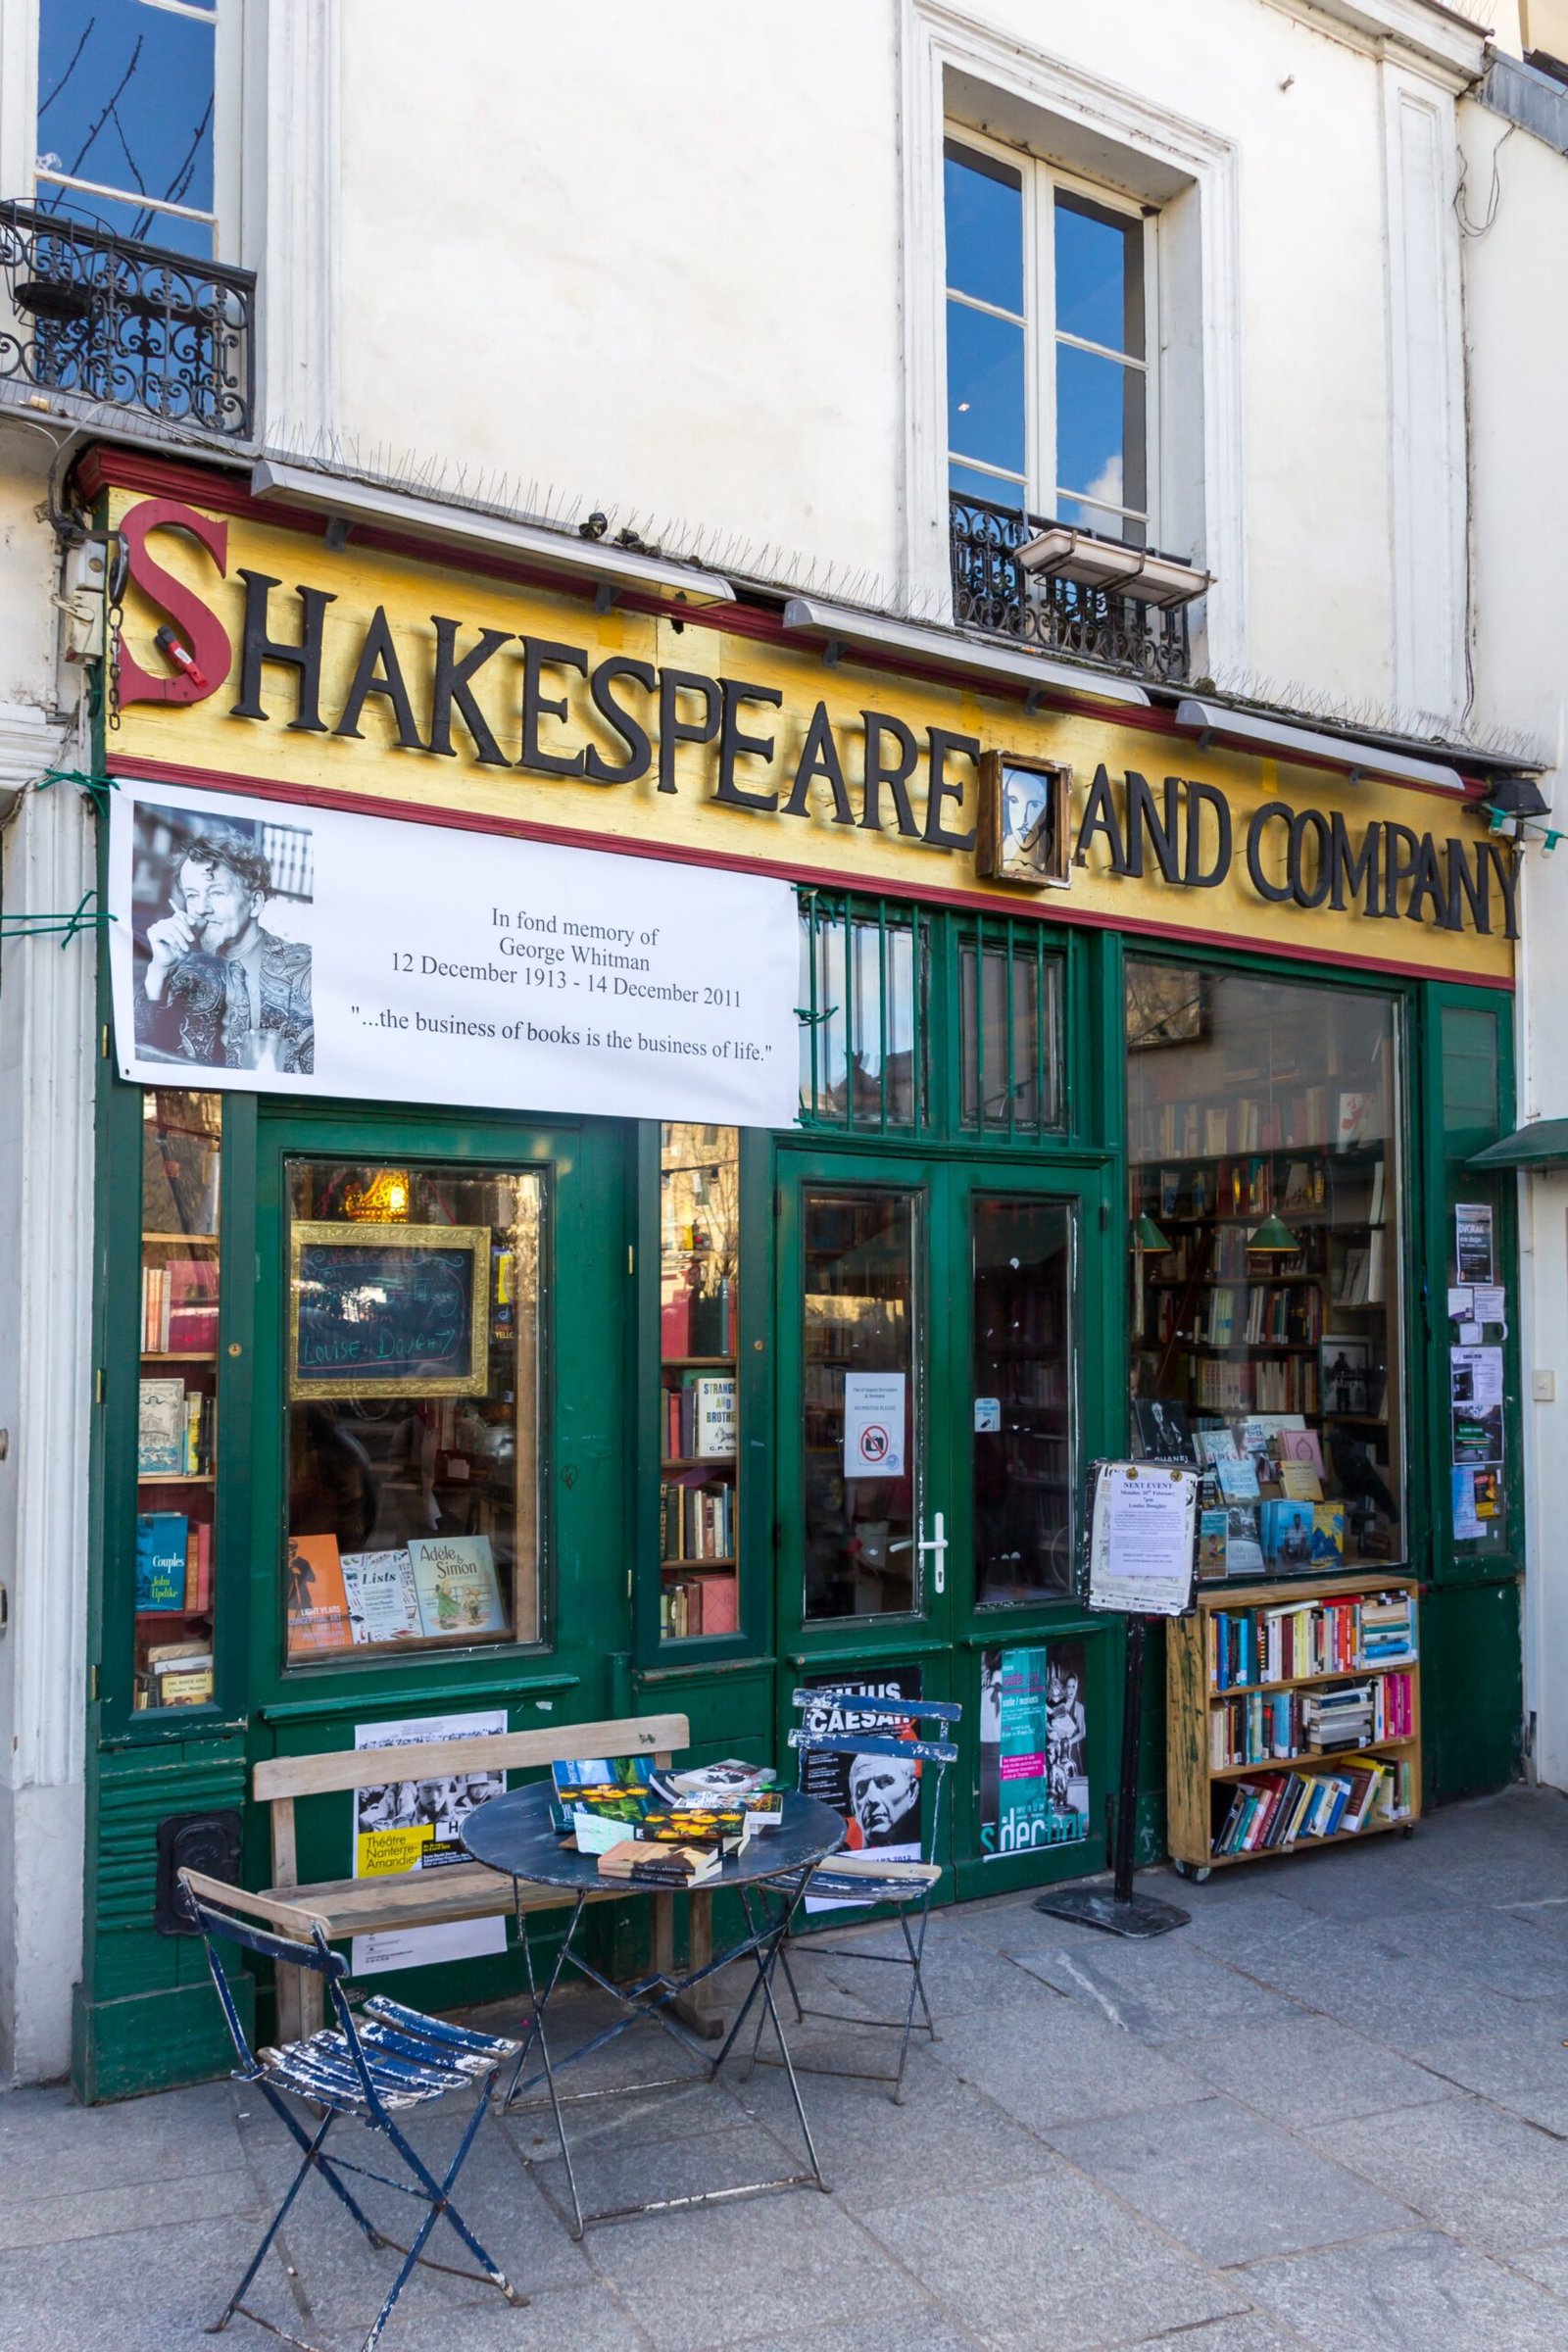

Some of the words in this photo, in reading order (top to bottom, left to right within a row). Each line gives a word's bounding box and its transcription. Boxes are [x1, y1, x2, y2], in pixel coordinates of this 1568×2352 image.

[119, 498, 981, 852] SHAKESPEARE
[1072, 762, 1232, 888] AND
[1246, 800, 1524, 940] COMPANY
[491, 907, 511, 927] In
[516, 910, 558, 933] fond
[563, 921, 635, 947] memory
[640, 928, 660, 946] of
[499, 937, 565, 964] George
[570, 945, 651, 971] Whitman
[392, 952, 414, 972] 12
[420, 955, 517, 984] December
[525, 967, 566, 989] 1913
[588, 974, 608, 993] 14
[613, 977, 699, 1003] December
[704, 987, 741, 1007] 2011
[416, 1011, 496, 1037] business
[502, 1021, 523, 1039] of
[527, 1022, 581, 1046] books
[586, 1027, 601, 1047] is
[607, 1030, 632, 1050] the
[638, 1032, 708, 1055] business
[712, 1041, 730, 1058] of
[734, 1042, 772, 1061] life."
[152, 1552, 185, 1574] Couples
[419, 1544, 457, 1563] Adèle
[362, 1571, 397, 1586] Lists
[436, 1560, 477, 1580] Simon
[151, 1575, 171, 1588] John
[366, 1835, 407, 1849] Théâtre
[366, 1844, 418, 1861] Nanterre-
